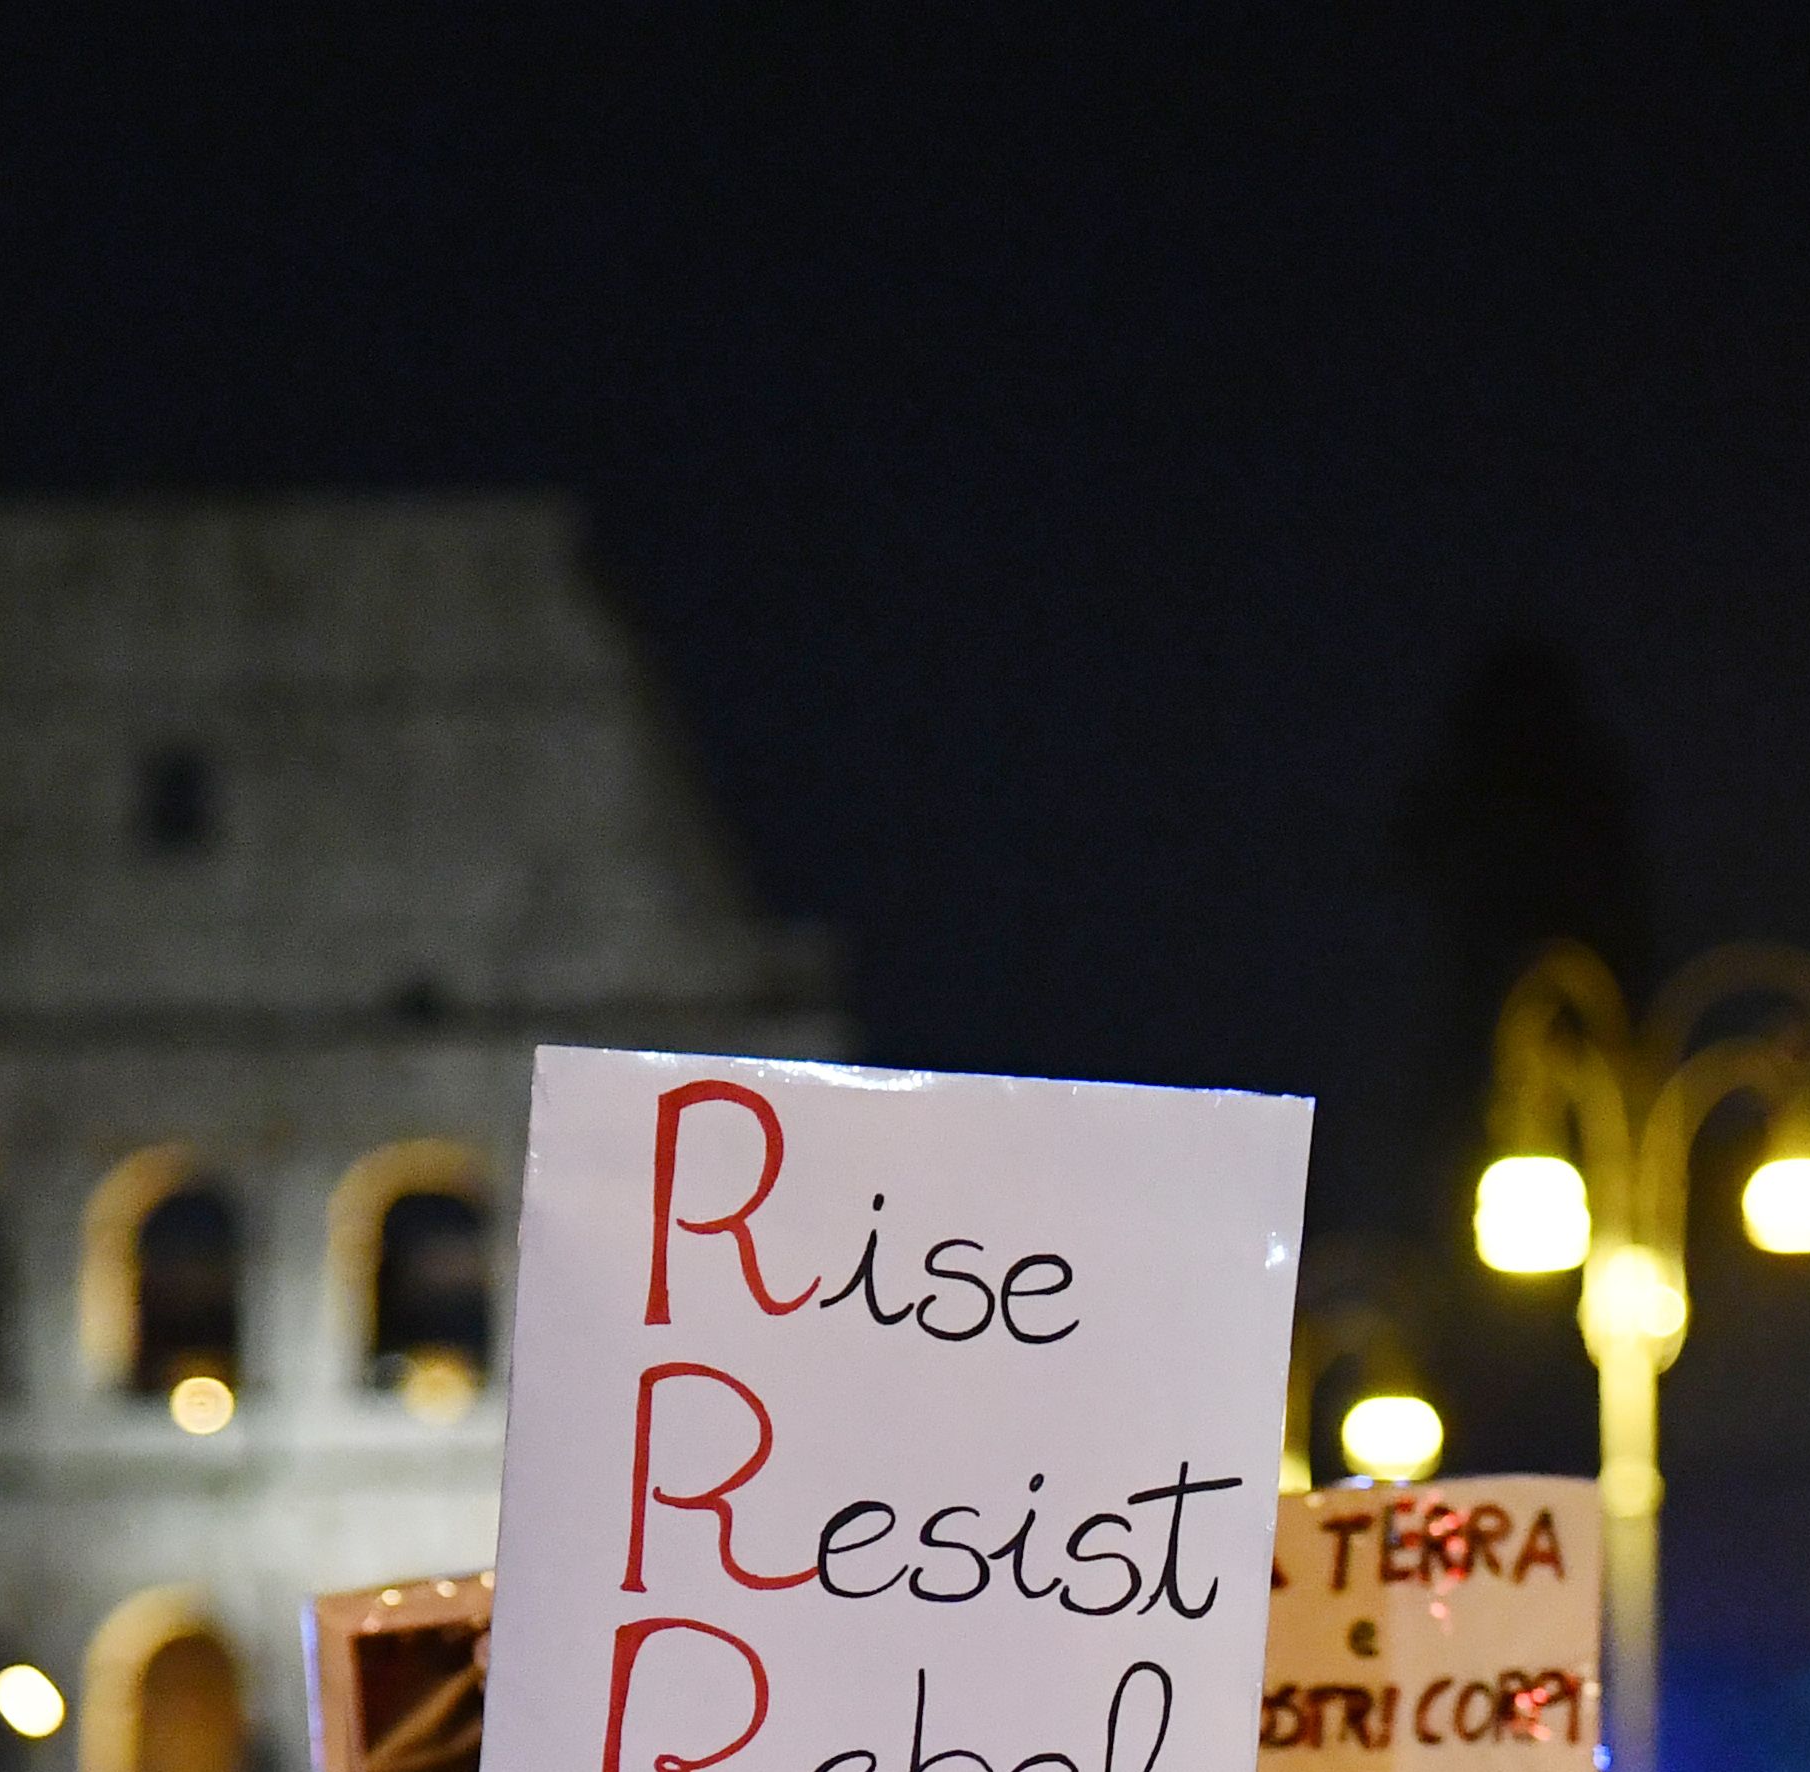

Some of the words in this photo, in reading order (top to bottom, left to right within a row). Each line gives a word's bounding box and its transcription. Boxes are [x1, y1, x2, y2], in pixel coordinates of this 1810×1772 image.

[644, 1079, 1079, 1345] Rise
[620, 1361, 1243, 1620] Resist
[1320, 1496, 1567, 1590] TERRA
[1347, 1617, 1380, 1659] e
